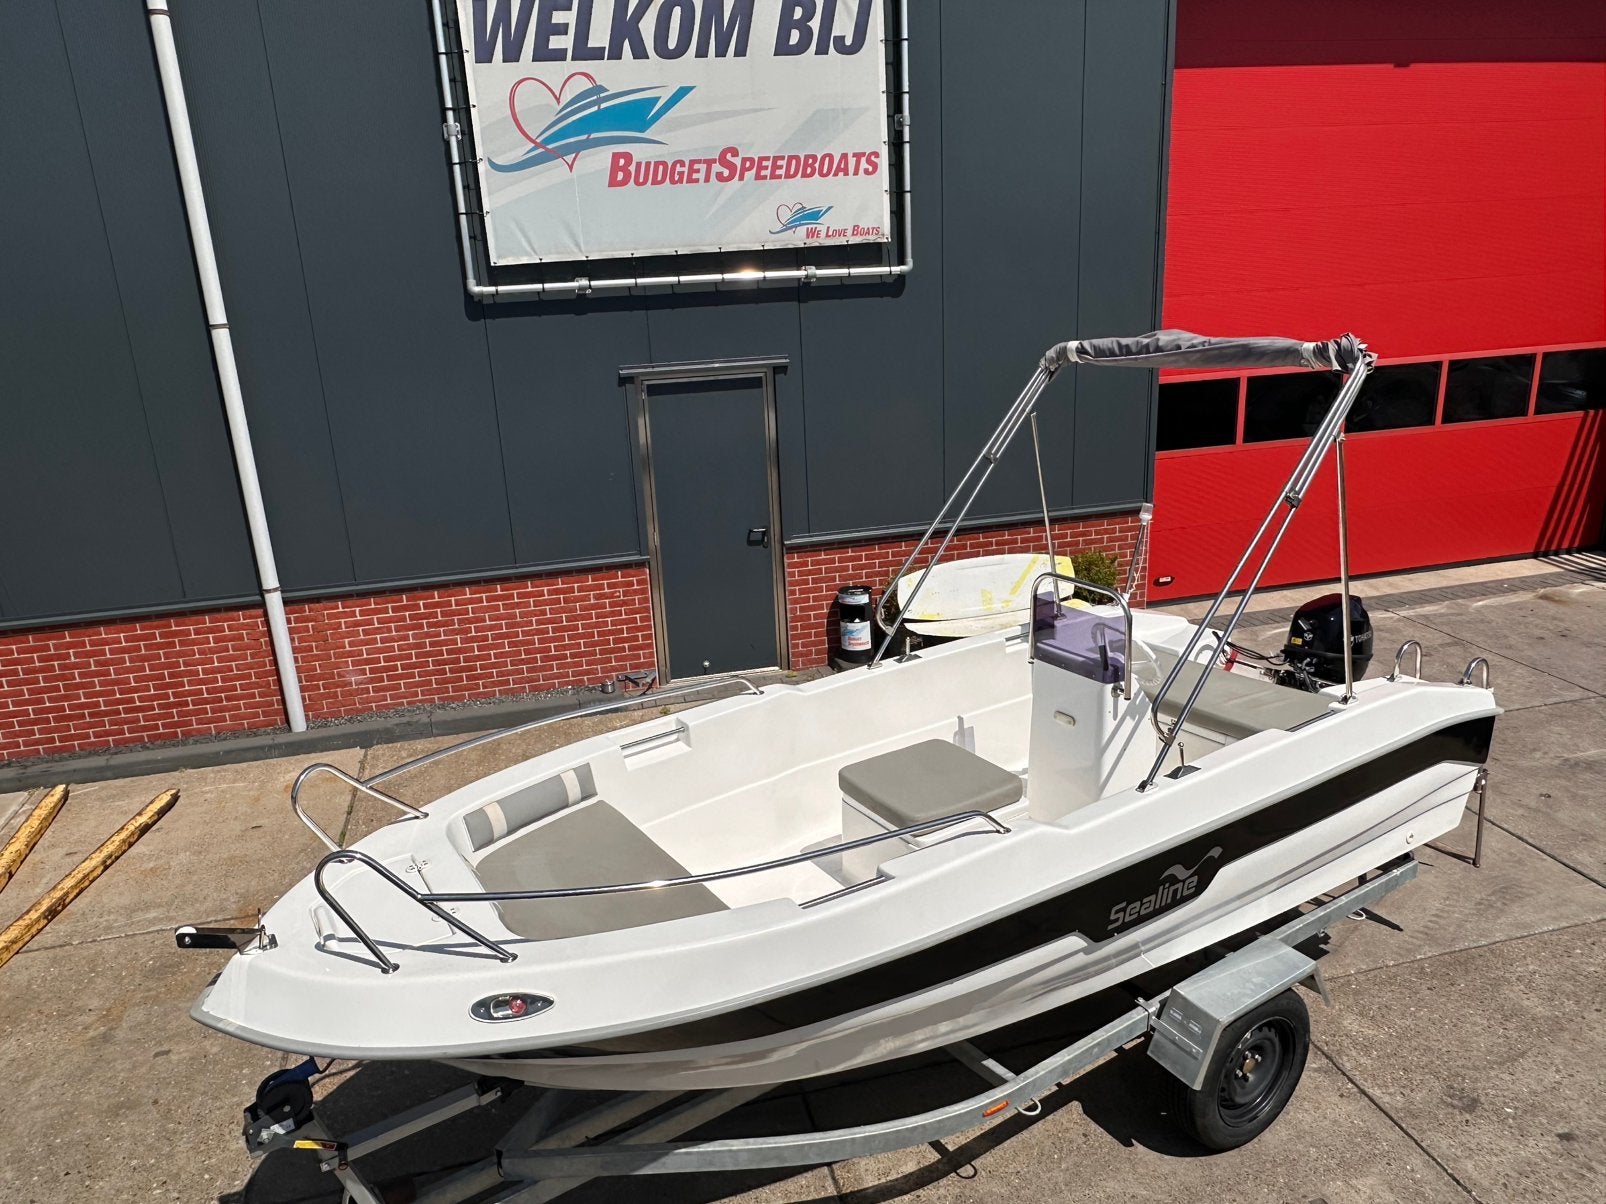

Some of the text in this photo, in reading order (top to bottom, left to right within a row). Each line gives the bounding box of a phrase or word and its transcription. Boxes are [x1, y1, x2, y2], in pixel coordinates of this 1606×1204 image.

[473, 0, 873, 63] WELKOM BIJ
[1107, 875, 1198, 930] Sealine
